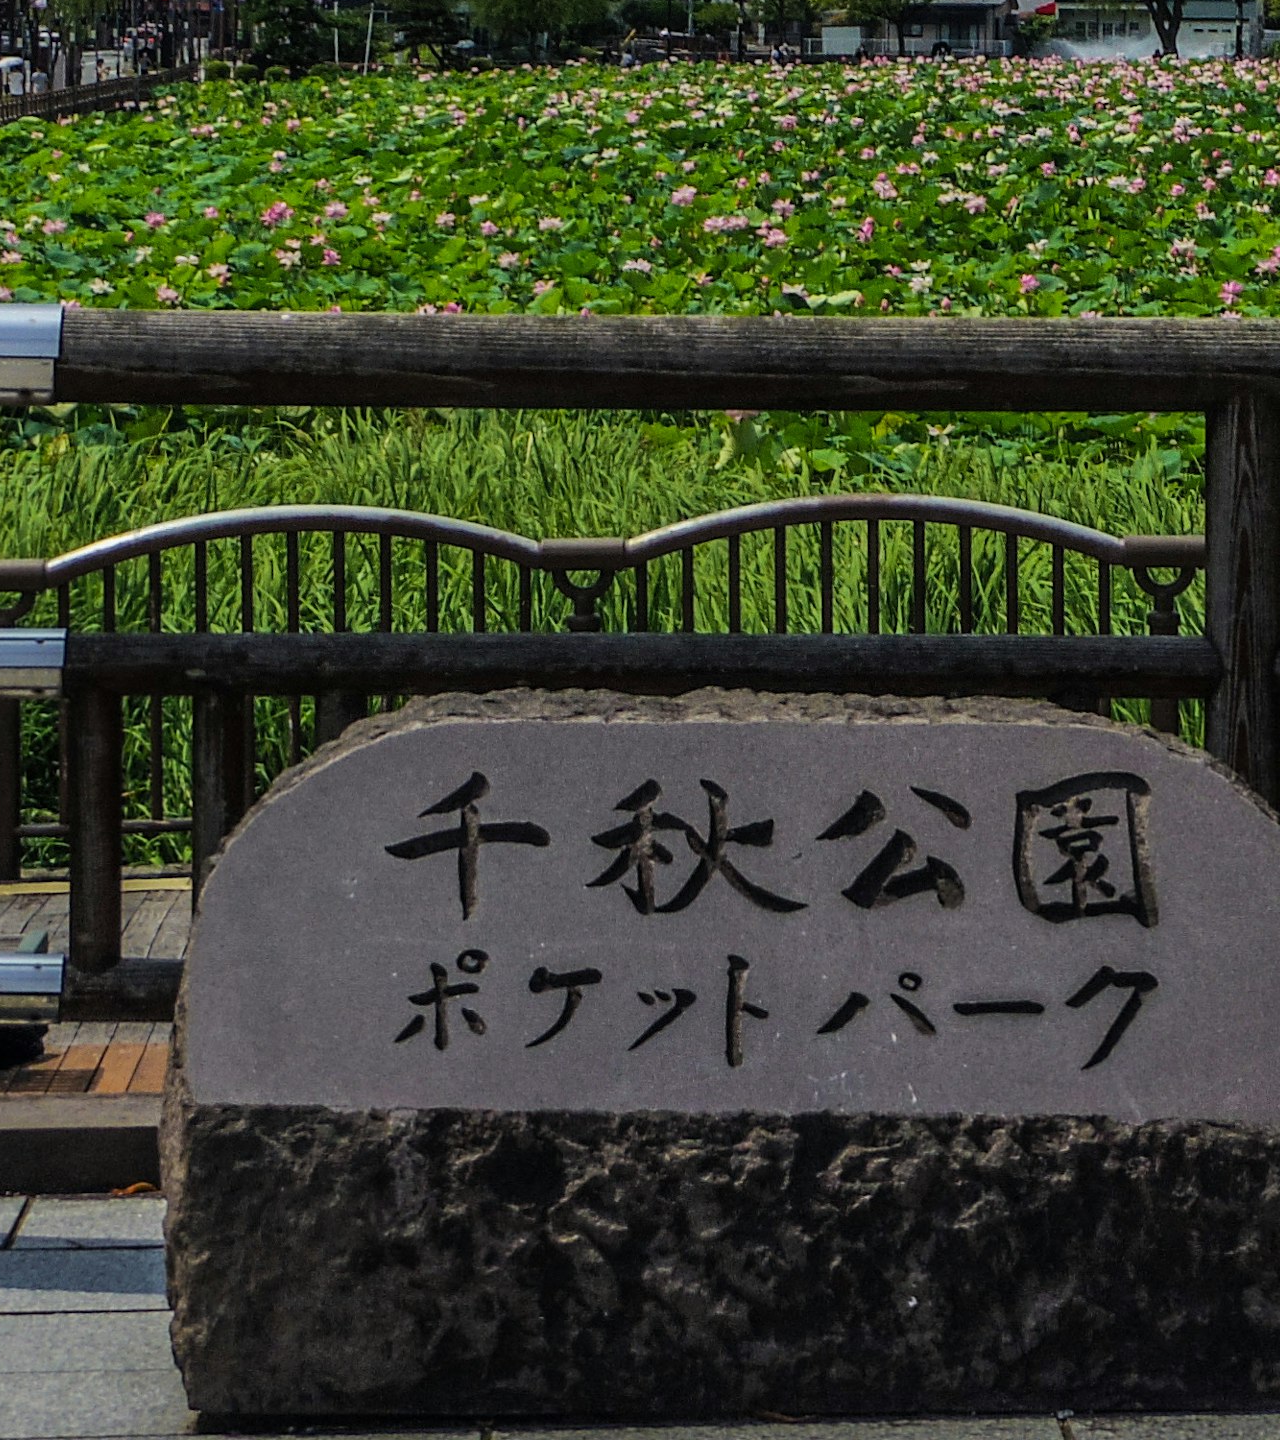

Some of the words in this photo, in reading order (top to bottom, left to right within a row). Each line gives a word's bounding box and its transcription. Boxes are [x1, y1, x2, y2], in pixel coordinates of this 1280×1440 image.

[384, 770, 1160, 929] 千秋公園
[393, 947, 1160, 1072] ポケットパーク
